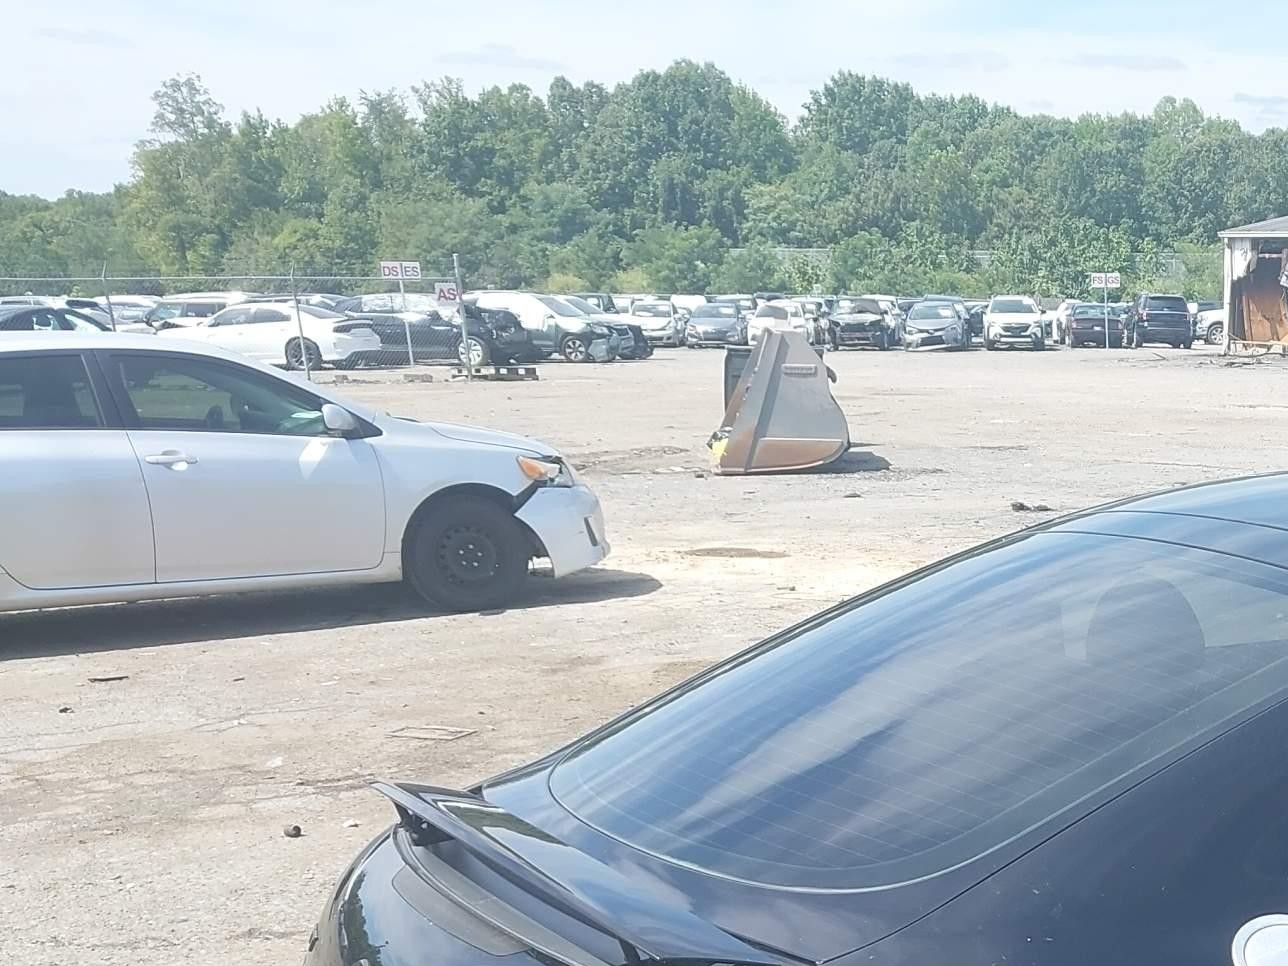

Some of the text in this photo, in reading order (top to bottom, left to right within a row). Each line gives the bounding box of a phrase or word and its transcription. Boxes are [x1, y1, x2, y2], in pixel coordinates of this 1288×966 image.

[382, 265, 420, 277] DS ES
[1092, 276, 1119, 284] FS GS
[438, 287, 457, 301] AS
